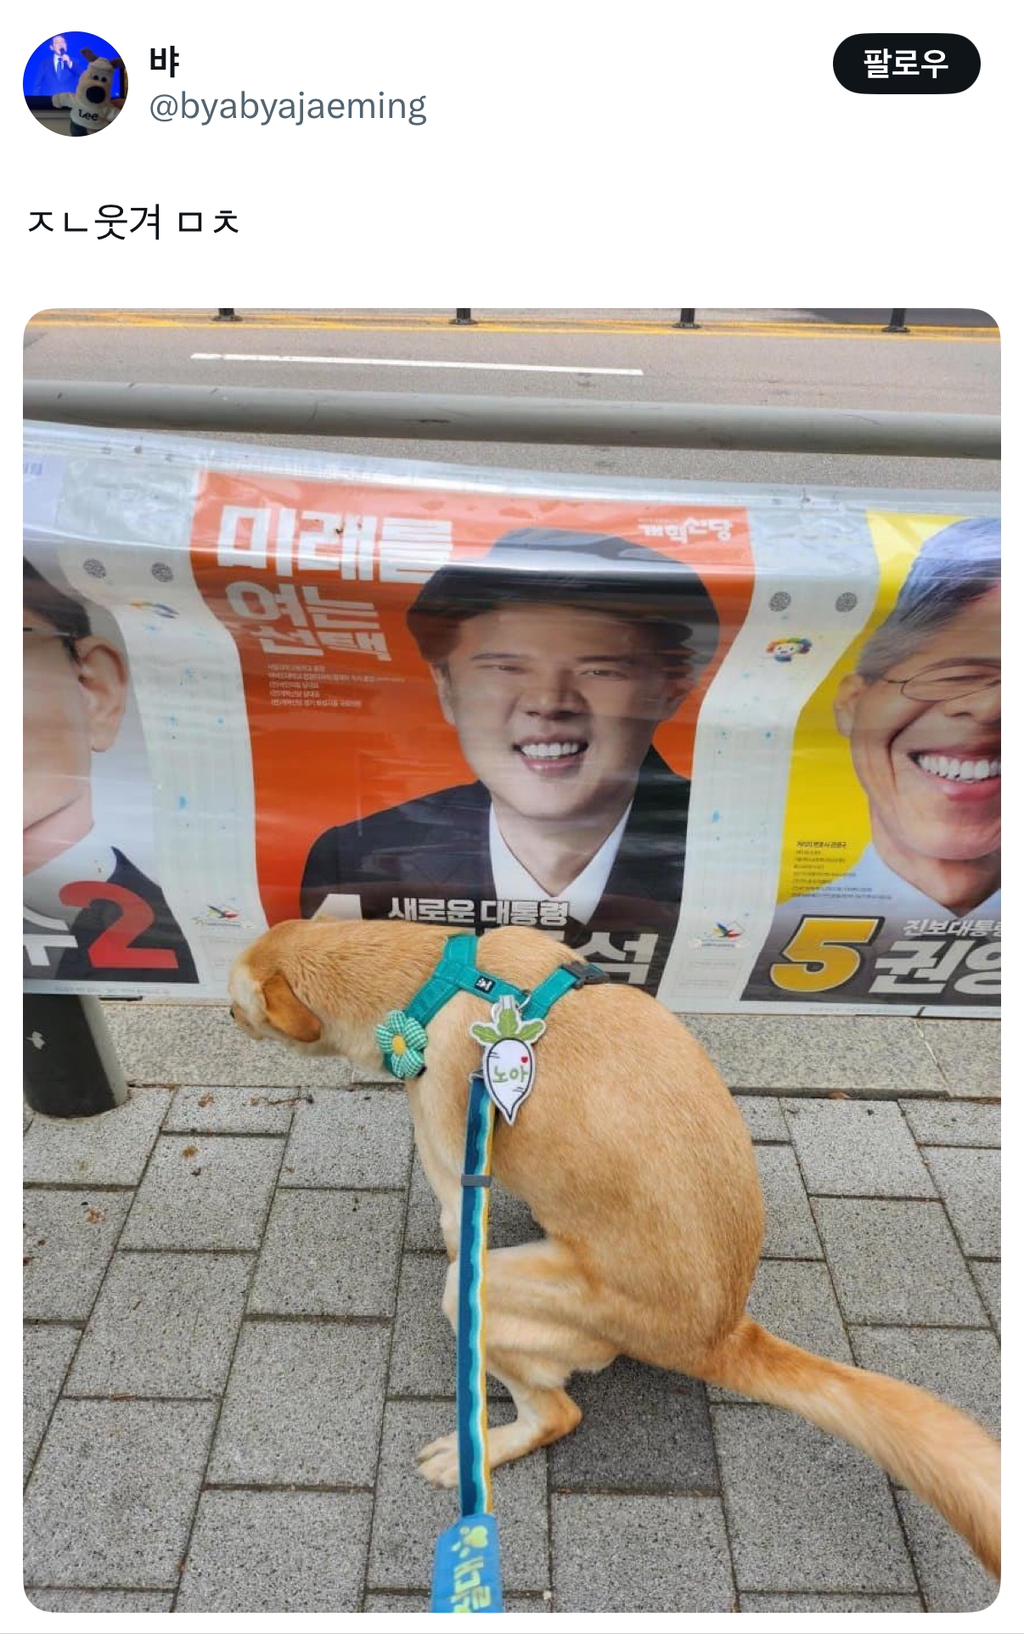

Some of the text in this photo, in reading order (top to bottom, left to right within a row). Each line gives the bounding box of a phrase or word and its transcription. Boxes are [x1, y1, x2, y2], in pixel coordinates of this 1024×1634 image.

[217, 505, 454, 584] 미래를
[225, 581, 380, 629] 여는
[252, 625, 392, 662] 선택
[59, 880, 179, 969] 2
[388, 896, 475, 924] 새로운
[480, 899, 569, 927] 대통령
[902, 918, 1001, 937] 진보대통
[769, 915, 886, 993] 5
[492, 1065, 529, 1083] 노아
